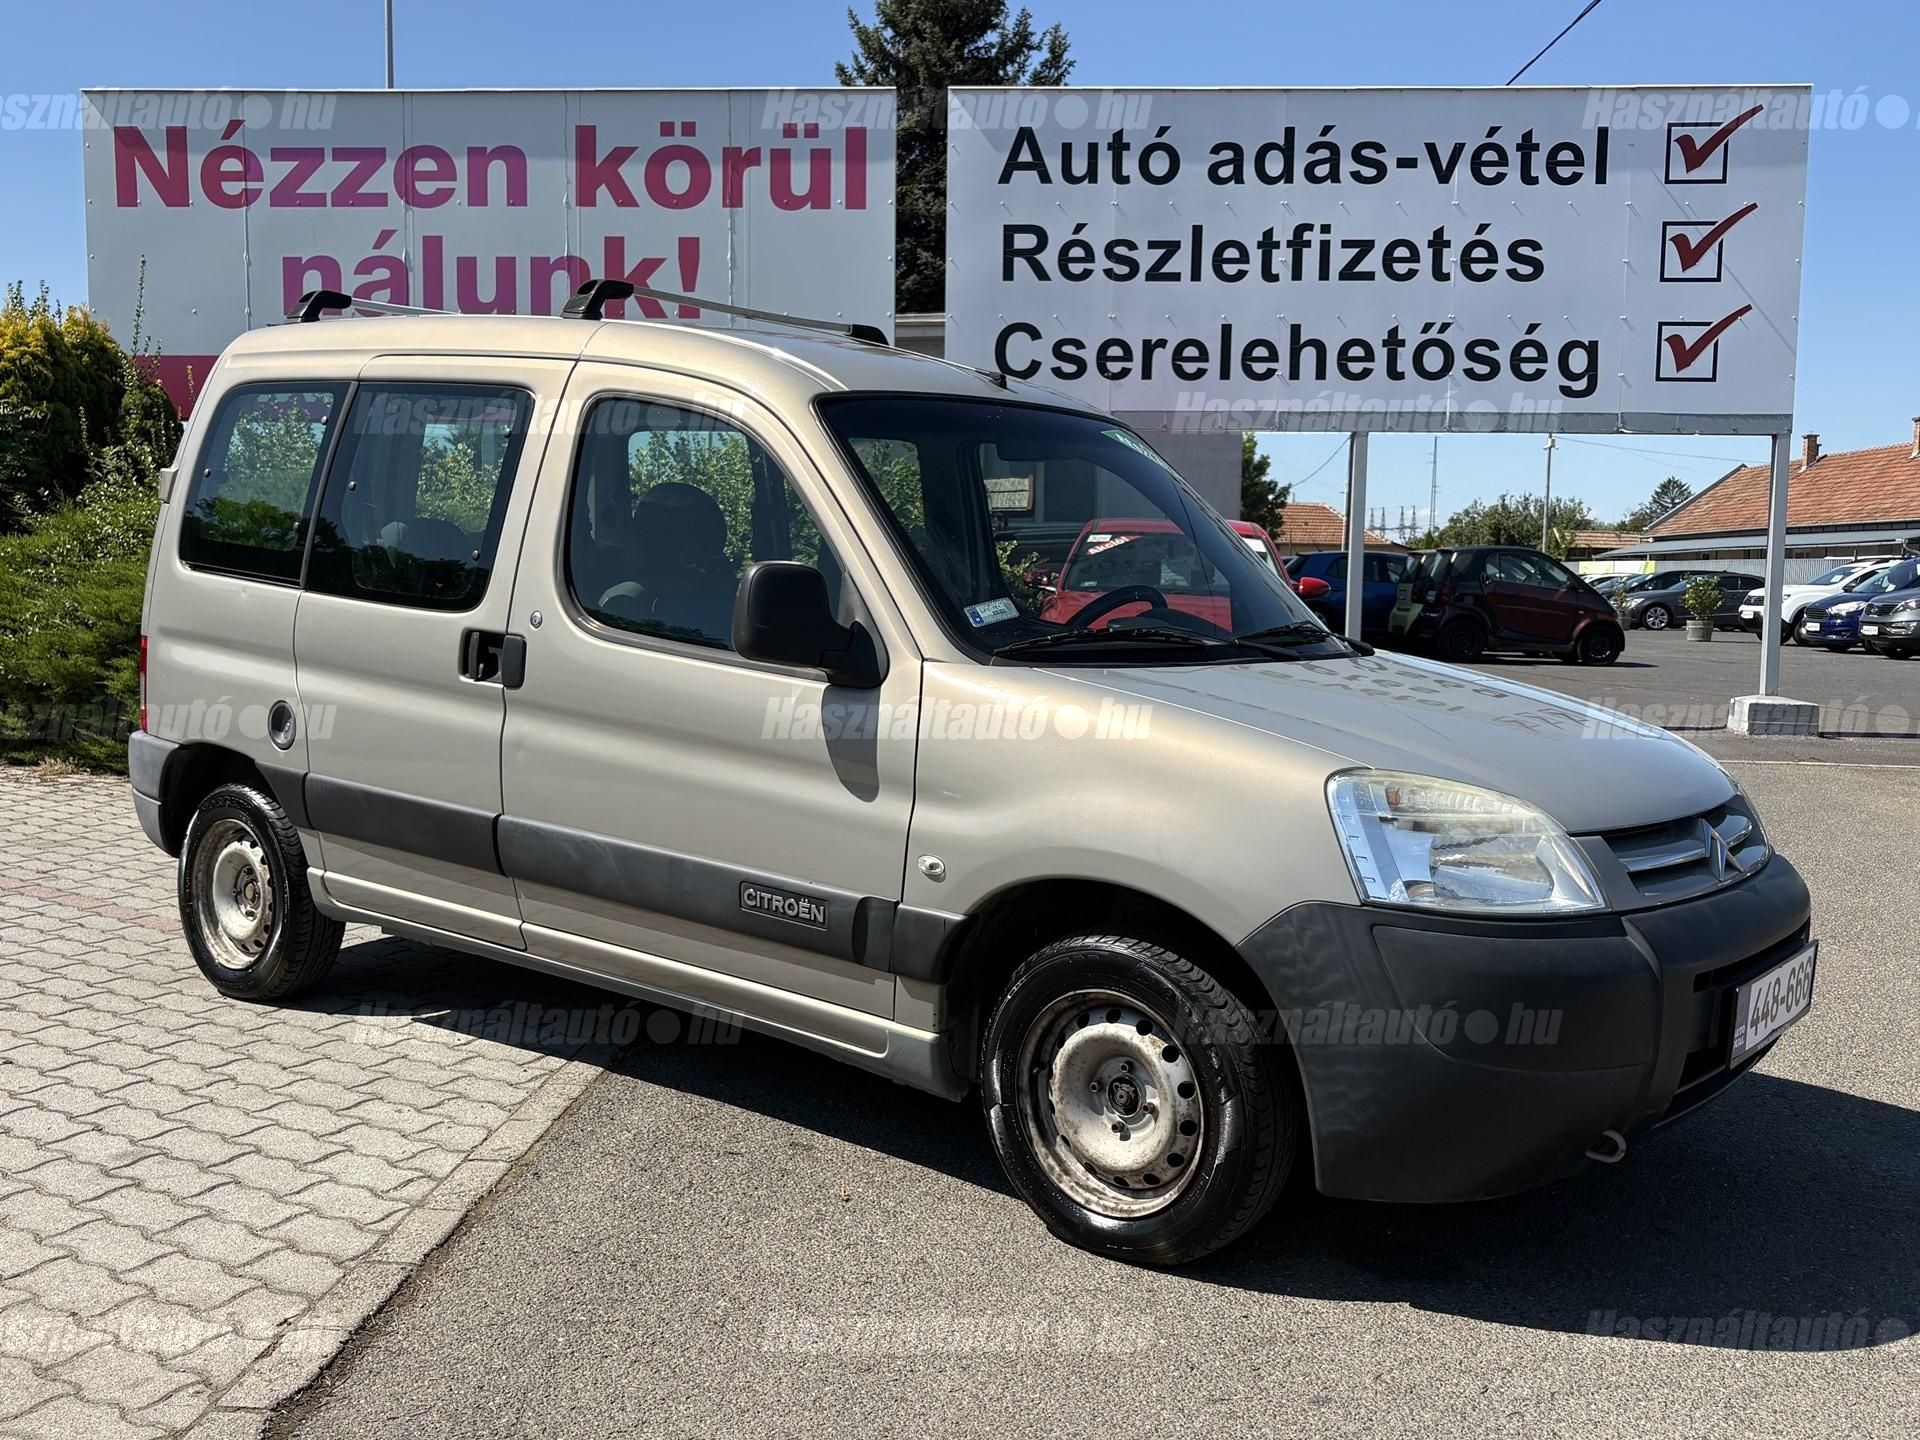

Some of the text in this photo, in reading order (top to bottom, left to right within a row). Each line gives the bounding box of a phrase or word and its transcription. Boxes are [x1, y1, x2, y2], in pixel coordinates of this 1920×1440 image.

[114, 119, 868, 210] Nézzen körül
[998, 123, 1609, 186] Autó adás-vétel
[282, 229, 701, 319] nálunk!
[1002, 221, 1544, 283] Részletfizetés
[994, 321, 1600, 399] Cserelehetőség
[743, 887, 825, 924] CITROËN
[1750, 955, 1812, 1036] 448-666
